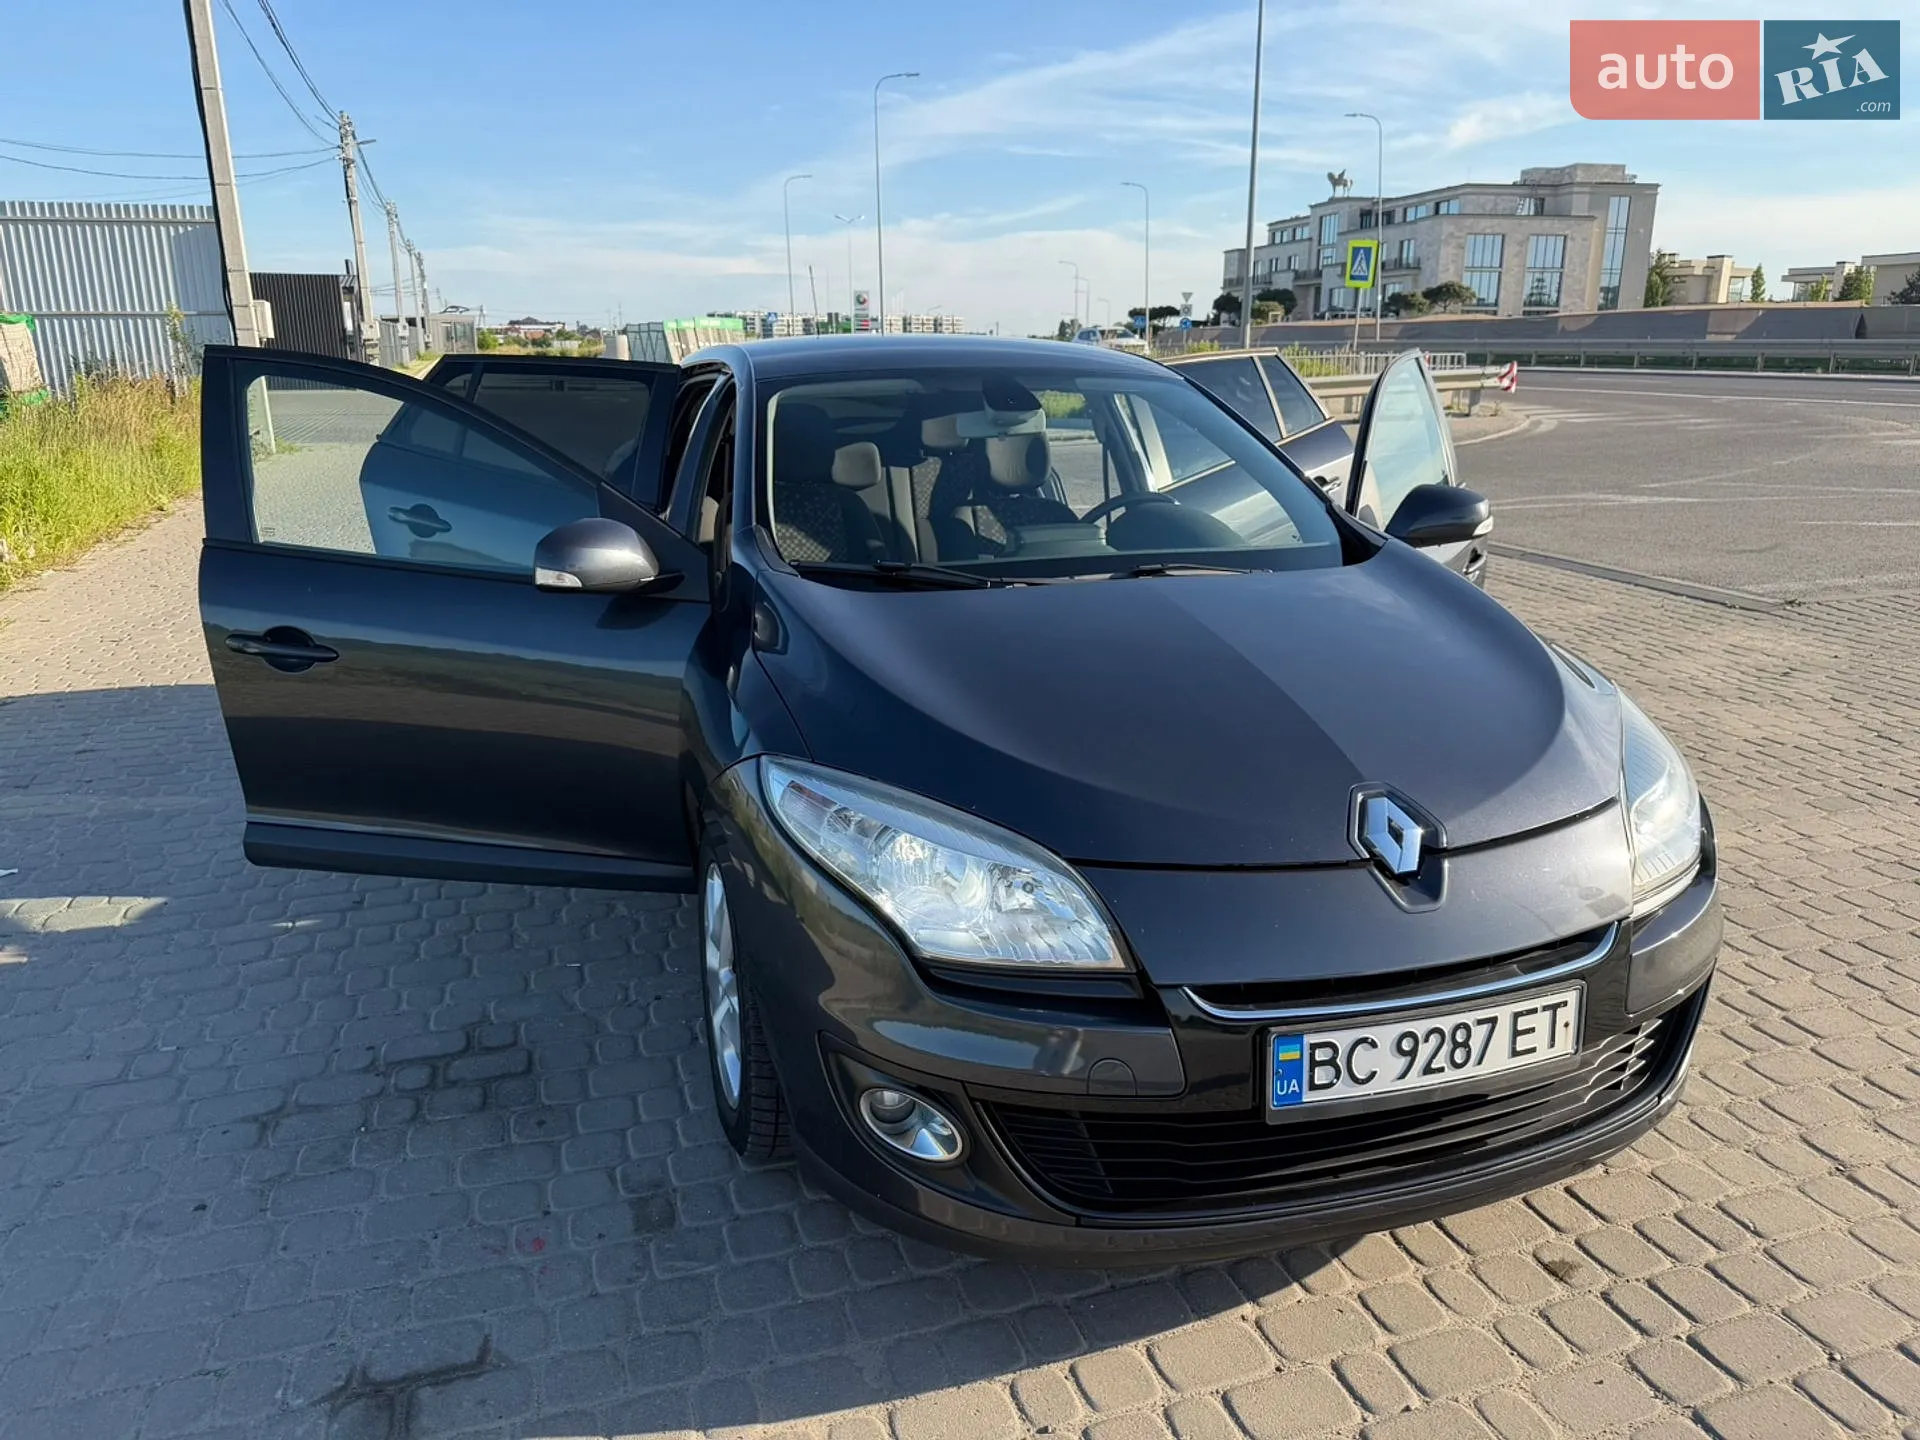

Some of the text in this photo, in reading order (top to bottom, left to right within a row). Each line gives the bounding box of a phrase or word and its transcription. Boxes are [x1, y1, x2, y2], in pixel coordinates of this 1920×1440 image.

[1308, 1000, 1568, 1091] BC 9287 ET
[1276, 1078, 1300, 1095] UA
